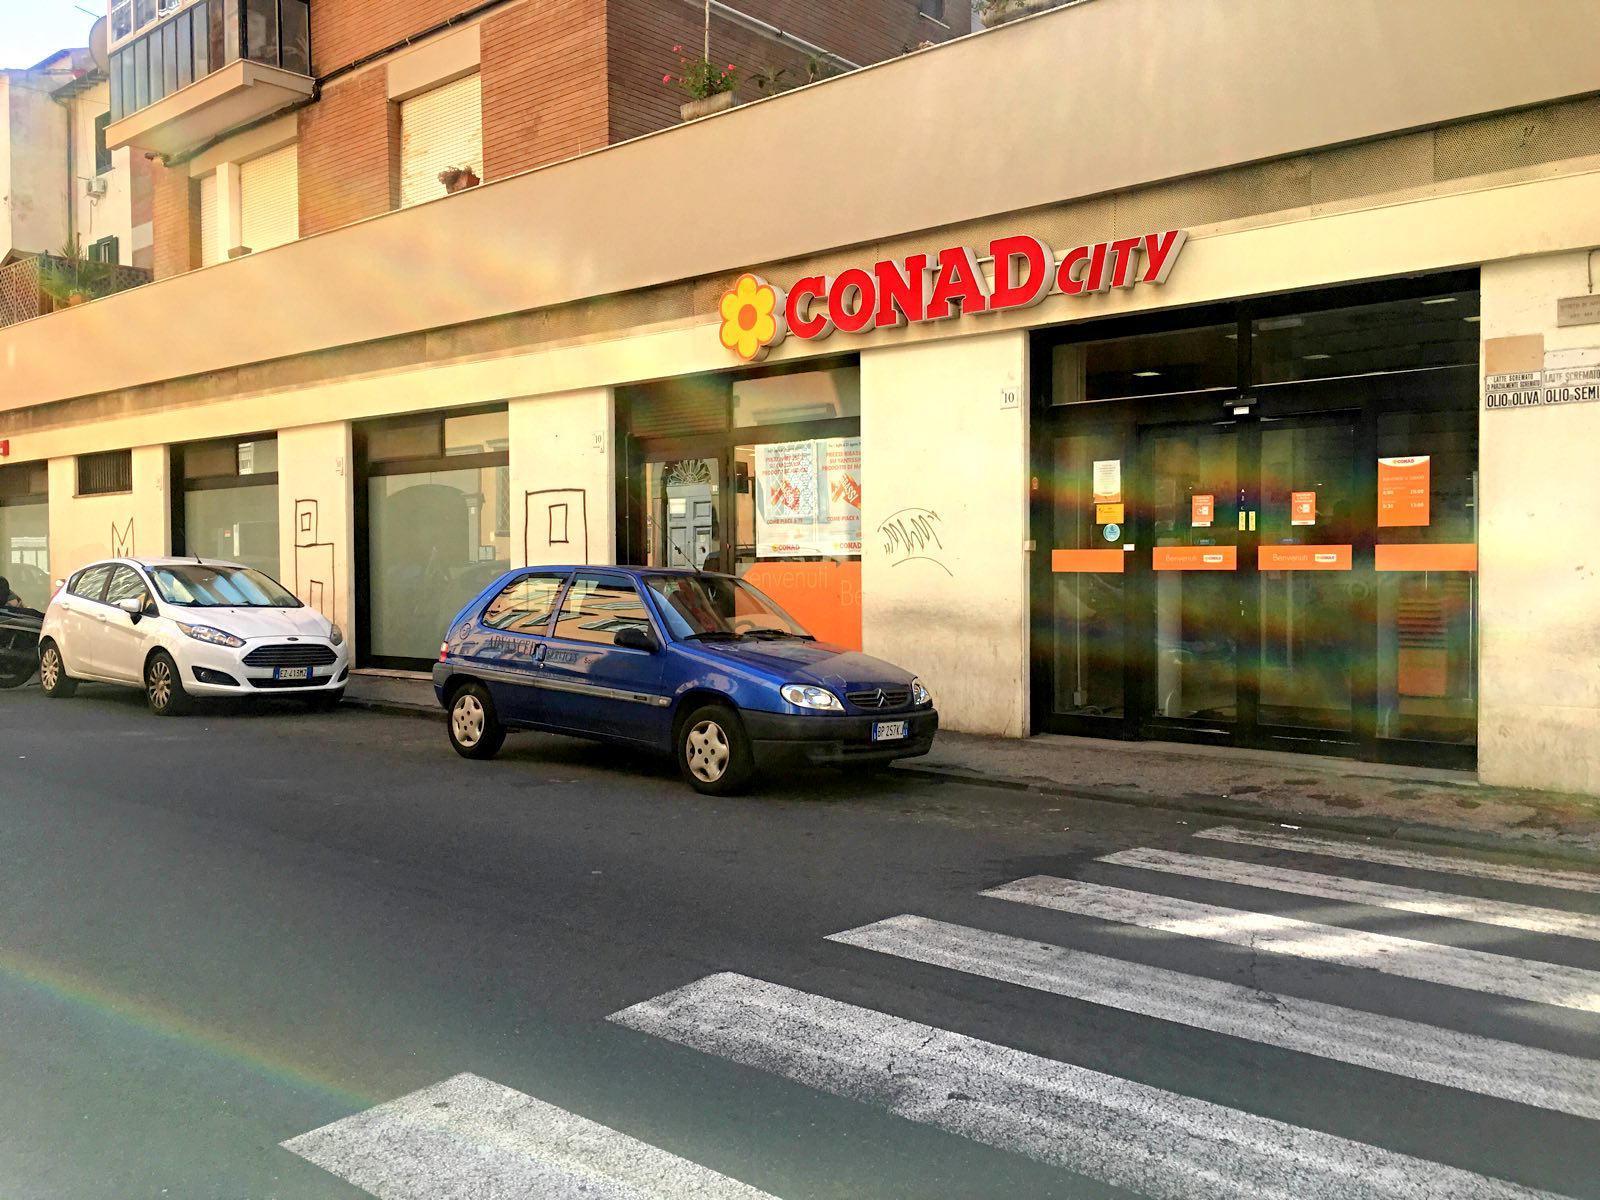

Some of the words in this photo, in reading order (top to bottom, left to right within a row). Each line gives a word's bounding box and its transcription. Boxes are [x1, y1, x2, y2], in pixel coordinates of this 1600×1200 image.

[786, 234, 1049, 341] CONAD
[1056, 230, 1183, 296] CITY
[1004, 391, 1015, 404] 10
[1487, 394, 1508, 408] OLIO
[1512, 391, 1540, 406] OLIVA
[1545, 388, 1569, 403] OLIO
[1574, 385, 1600, 401] SEMI
